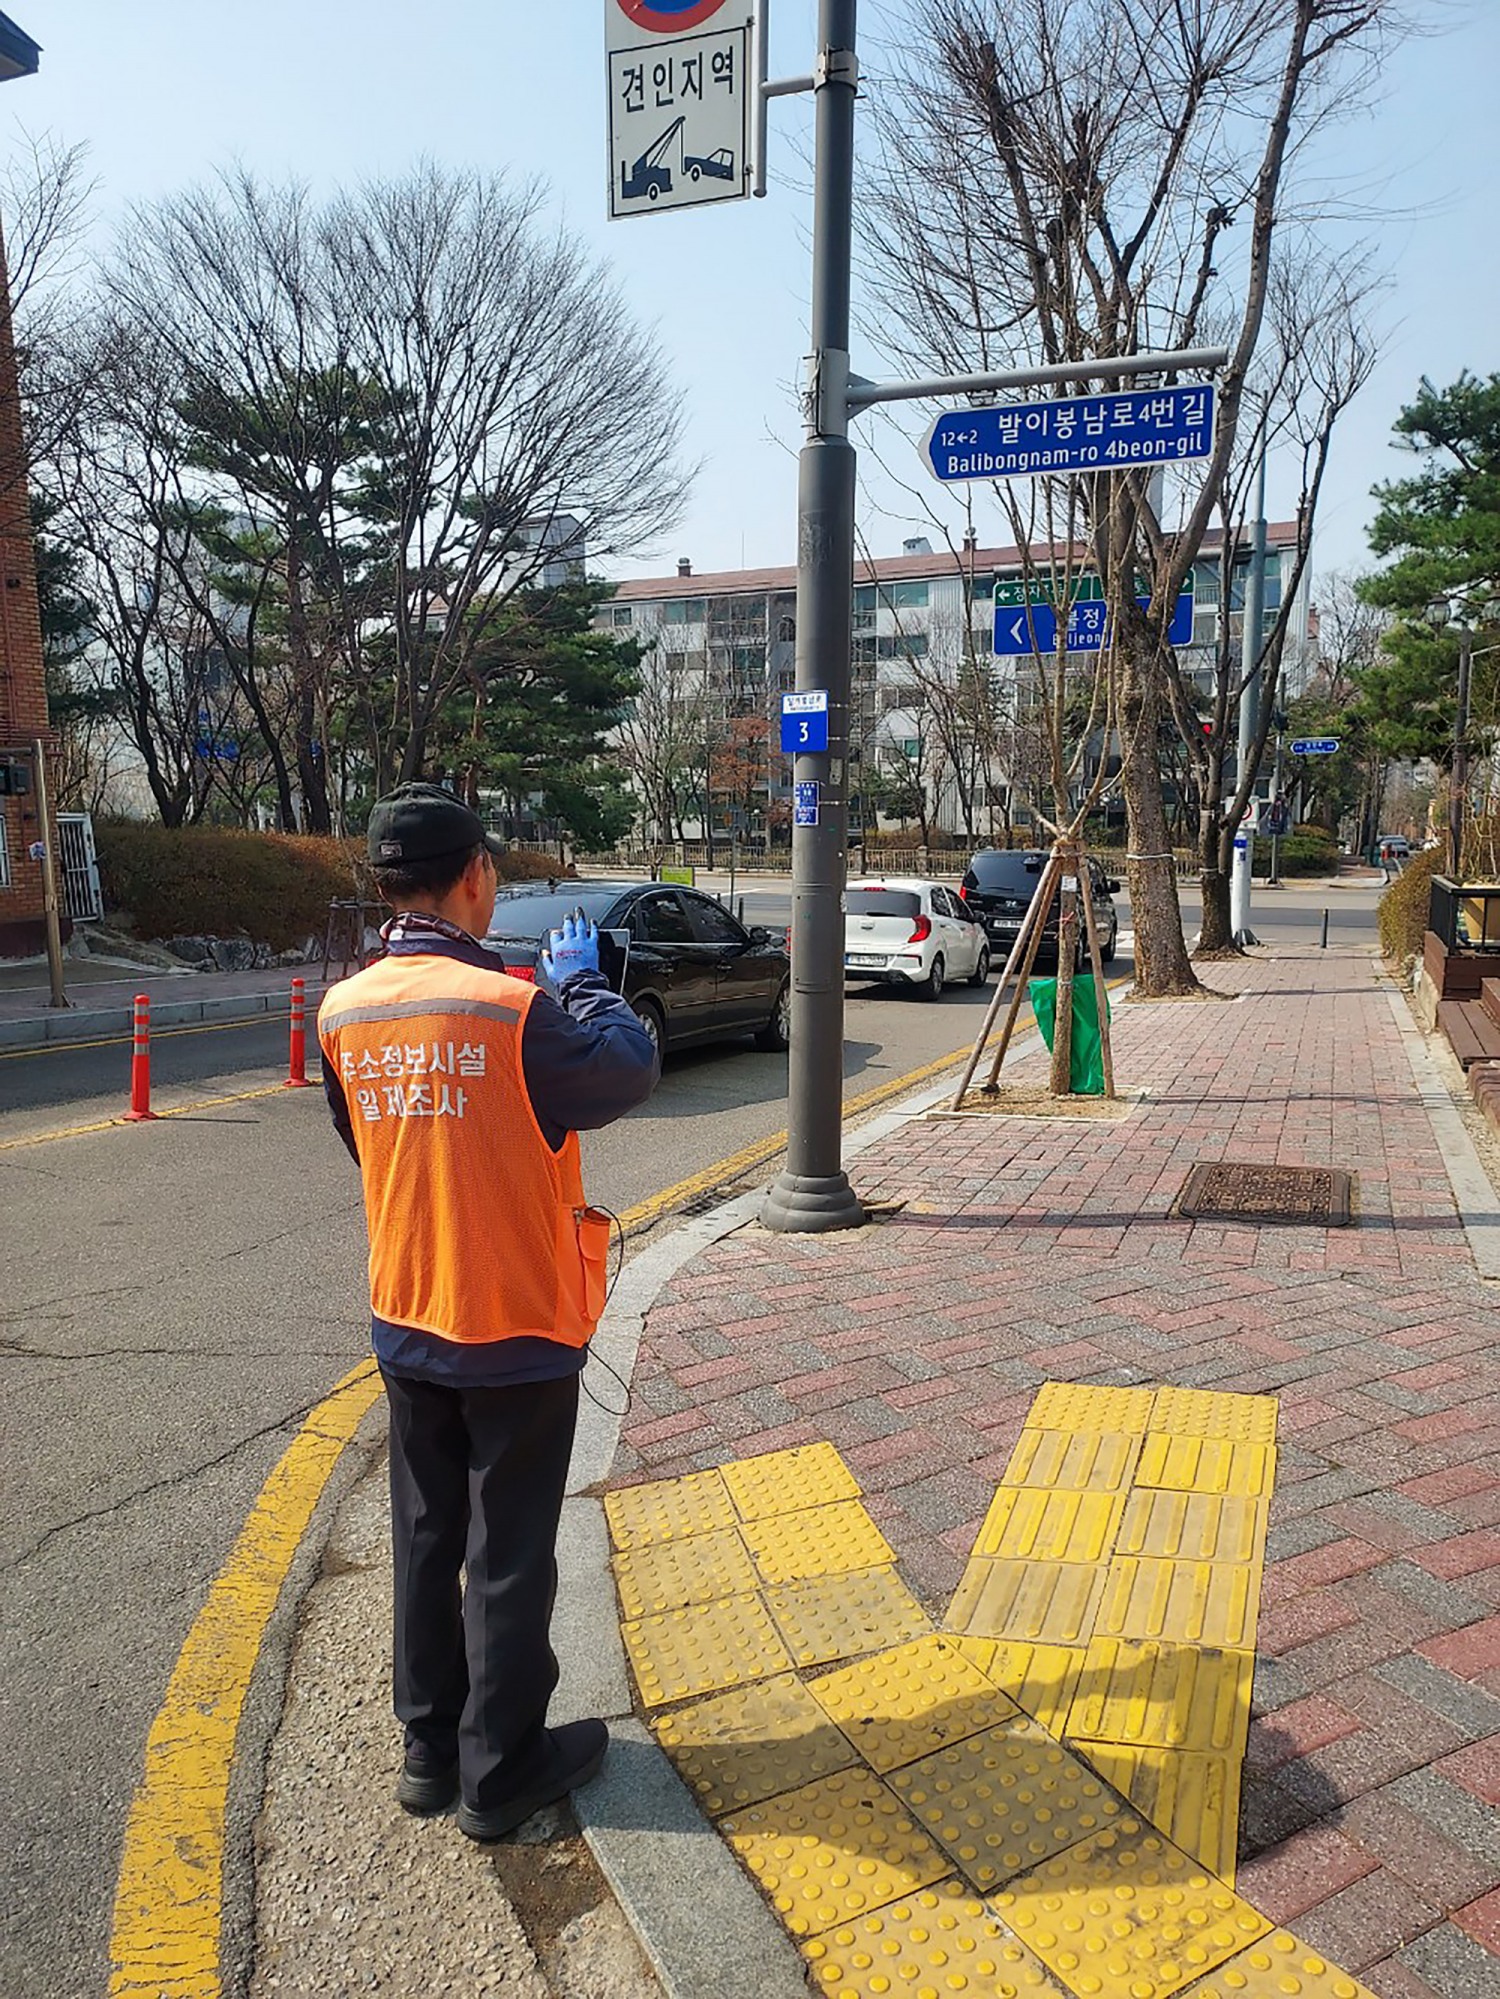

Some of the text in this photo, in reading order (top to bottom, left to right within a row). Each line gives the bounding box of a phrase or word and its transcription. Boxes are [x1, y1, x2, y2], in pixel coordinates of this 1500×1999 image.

[622, 45, 734, 113] 견인지역
[999, 393, 1206, 445] 발이봉남로4번길
[948, 432, 1203, 474] Balibongnam-ro 4beon-gil
[799, 721, 809, 743] 3
[340, 1041, 486, 1083] 주소정보시설
[356, 1083, 469, 1122] 일제조사
